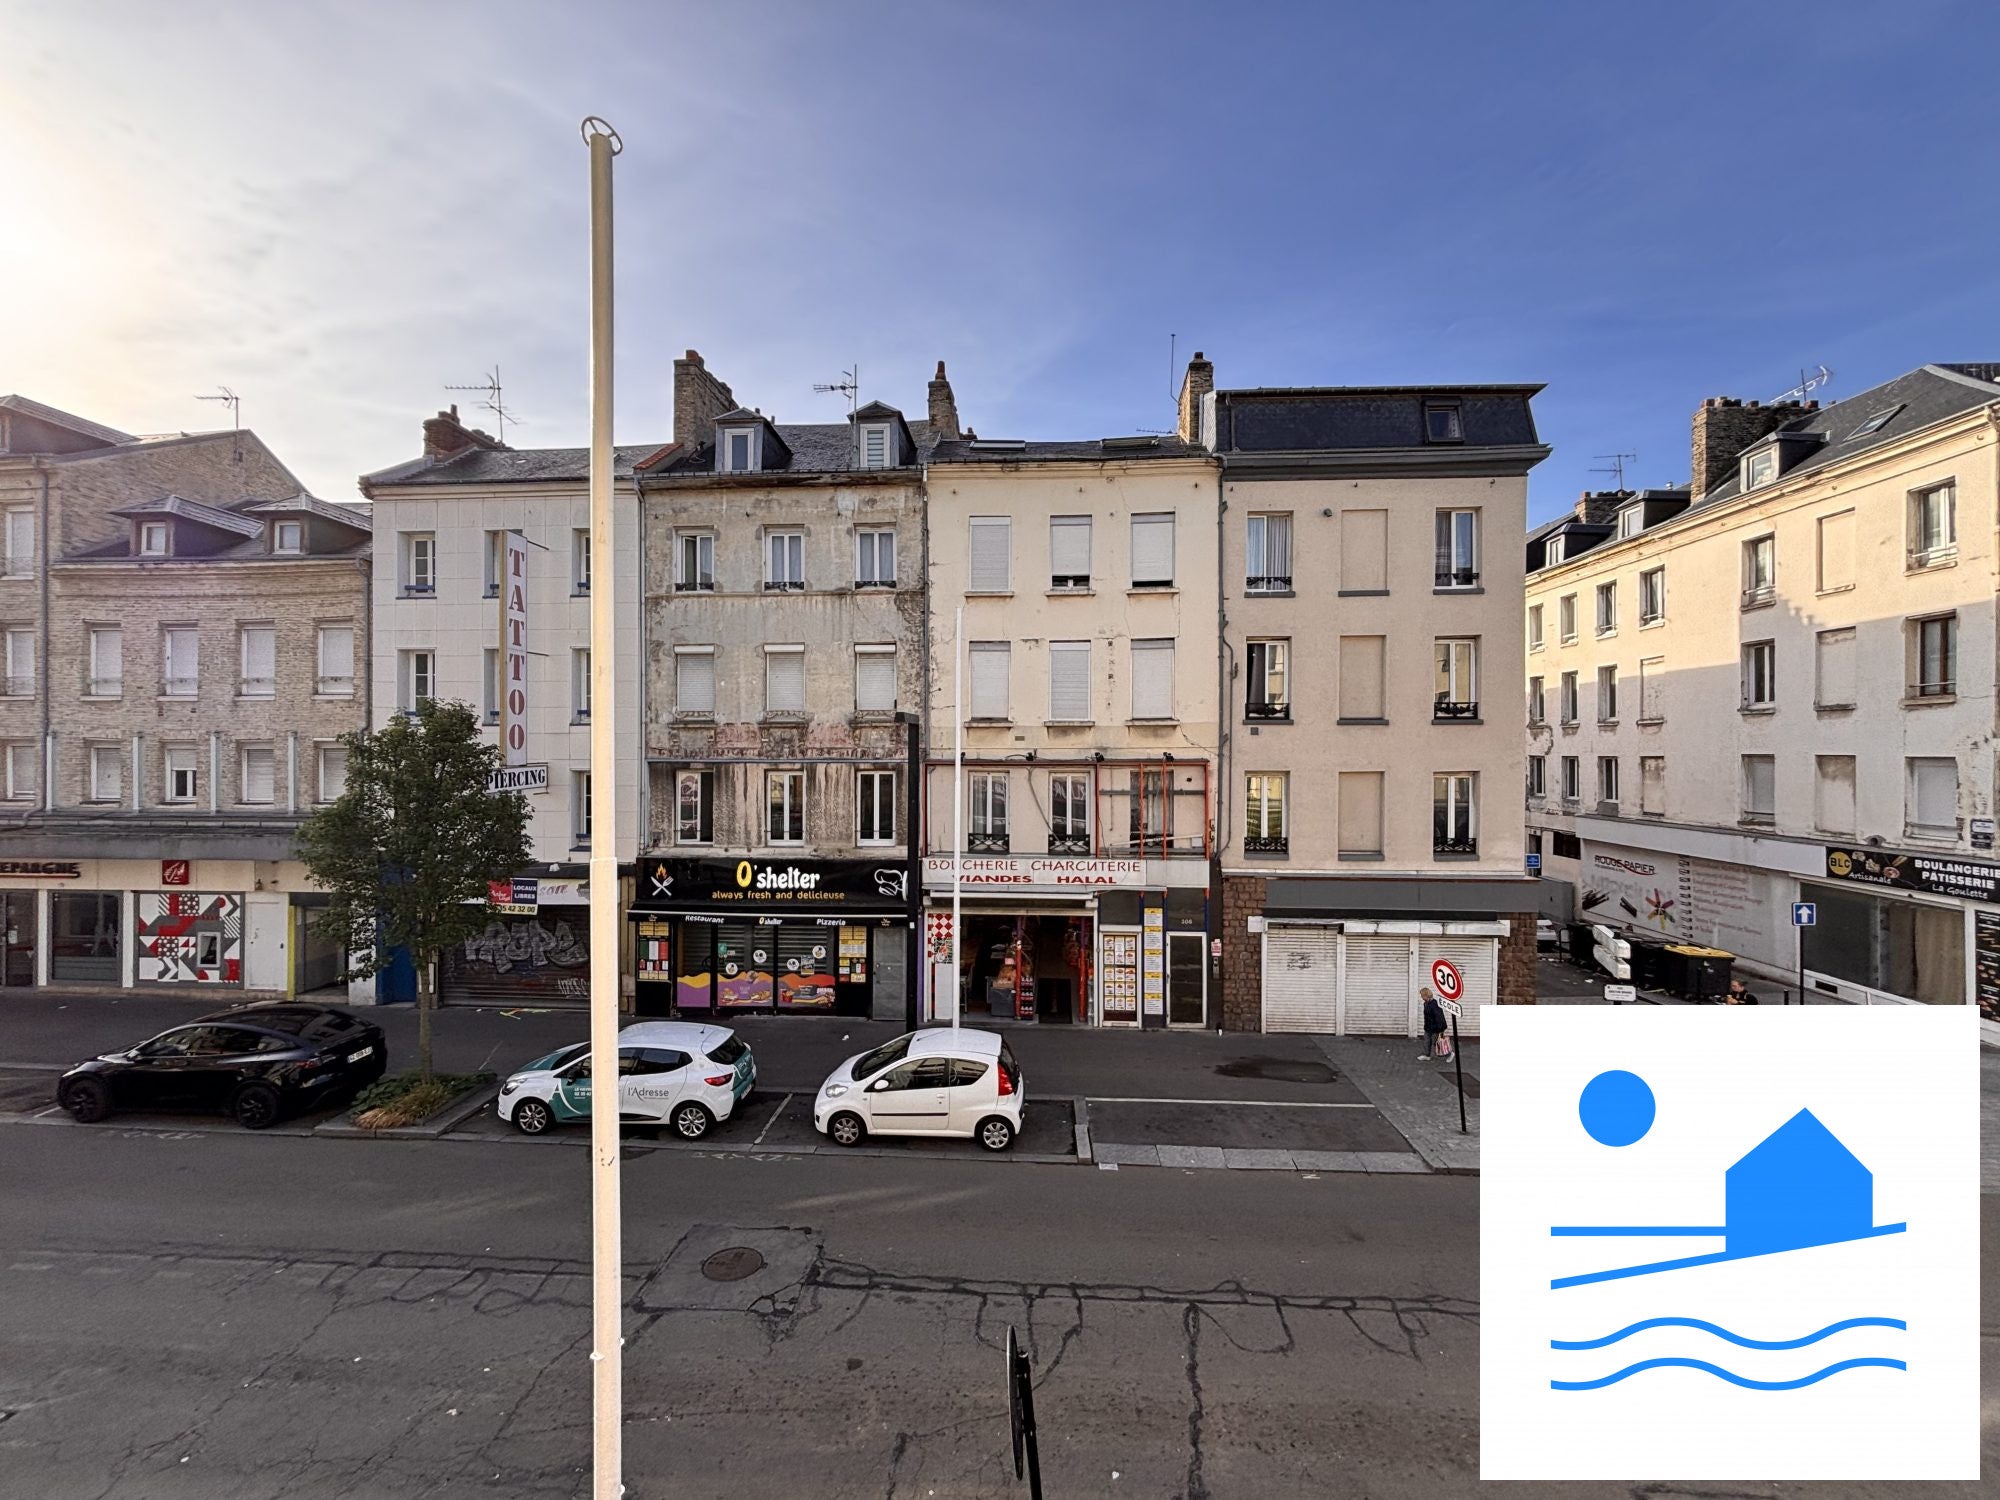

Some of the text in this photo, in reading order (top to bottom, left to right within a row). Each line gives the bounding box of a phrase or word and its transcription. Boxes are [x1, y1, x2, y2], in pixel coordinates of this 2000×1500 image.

[508, 547, 526, 751] TATTOO
[486, 767, 546, 793] PIERCING
[1030, 859, 1142, 872] CHARCUTERIE
[1624, 860, 1656, 875] PAPIER
[1830, 857, 1850, 868] BLC
[736, 860, 821, 889] O'shelter
[1914, 859, 2000, 879] BOULANGERIE
[1057, 875, 1117, 884] HALAL
[1932, 883, 1945, 892] La
[712, 890, 744, 900] always
[747, 890, 771, 899] fresh
[775, 890, 793, 899] and
[508, 904, 515, 912] 42
[517, 904, 525, 912] 32
[685, 915, 725, 924] Restaurant
[816, 918, 846, 927] Pizzeria
[1437, 968, 1456, 991] 30
